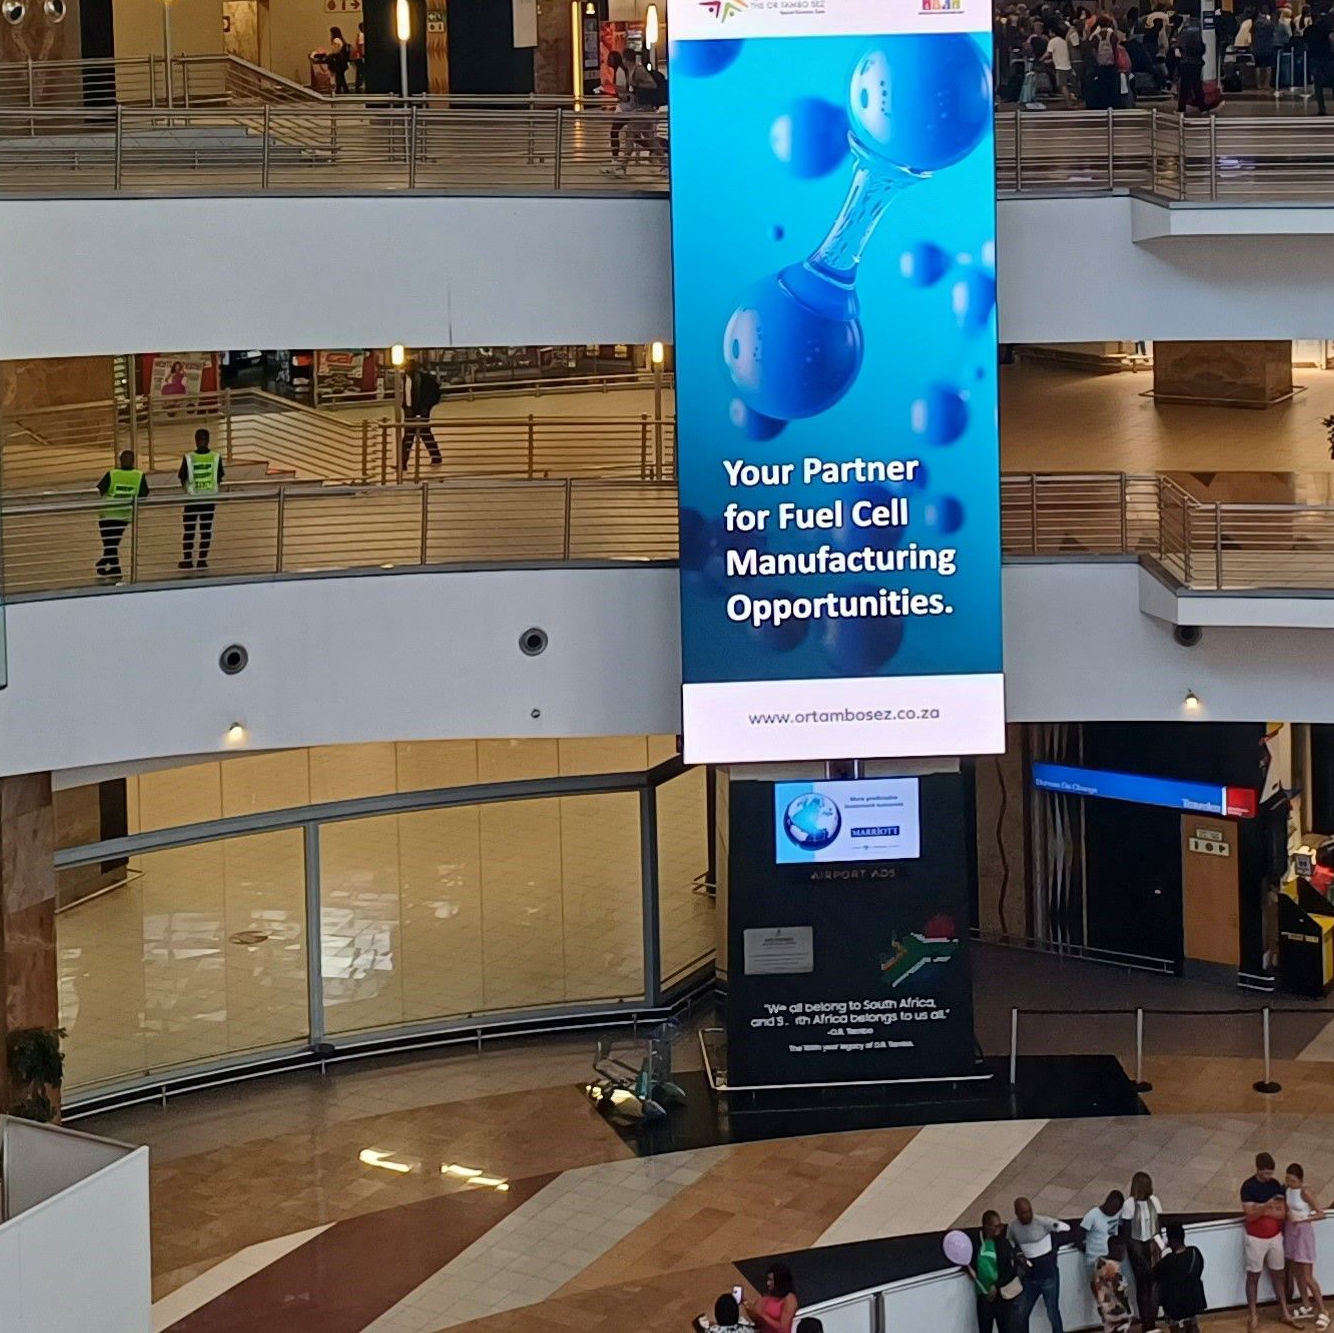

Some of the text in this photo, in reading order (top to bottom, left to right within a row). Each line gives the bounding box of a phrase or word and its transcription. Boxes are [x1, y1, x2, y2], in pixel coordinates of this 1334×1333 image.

[723, 456, 919, 488] Your Partner
[723, 497, 909, 532] for Fuel Cell
[725, 543, 957, 577] Manufacturing
[726, 588, 954, 627] Opportunities.
[748, 706, 941, 725] www.ortambosez.co.za
[750, 1016, 776, 1027] and
[812, 1013, 848, 1025] Africa
[849, 1013, 898, 1025] belongs
[900, 1011, 913, 1021] to
[914, 1011, 929, 1021] us
[805, 1001, 848, 1014] belong
[848, 1000, 862, 1011] to
[863, 999, 898, 1010] South
